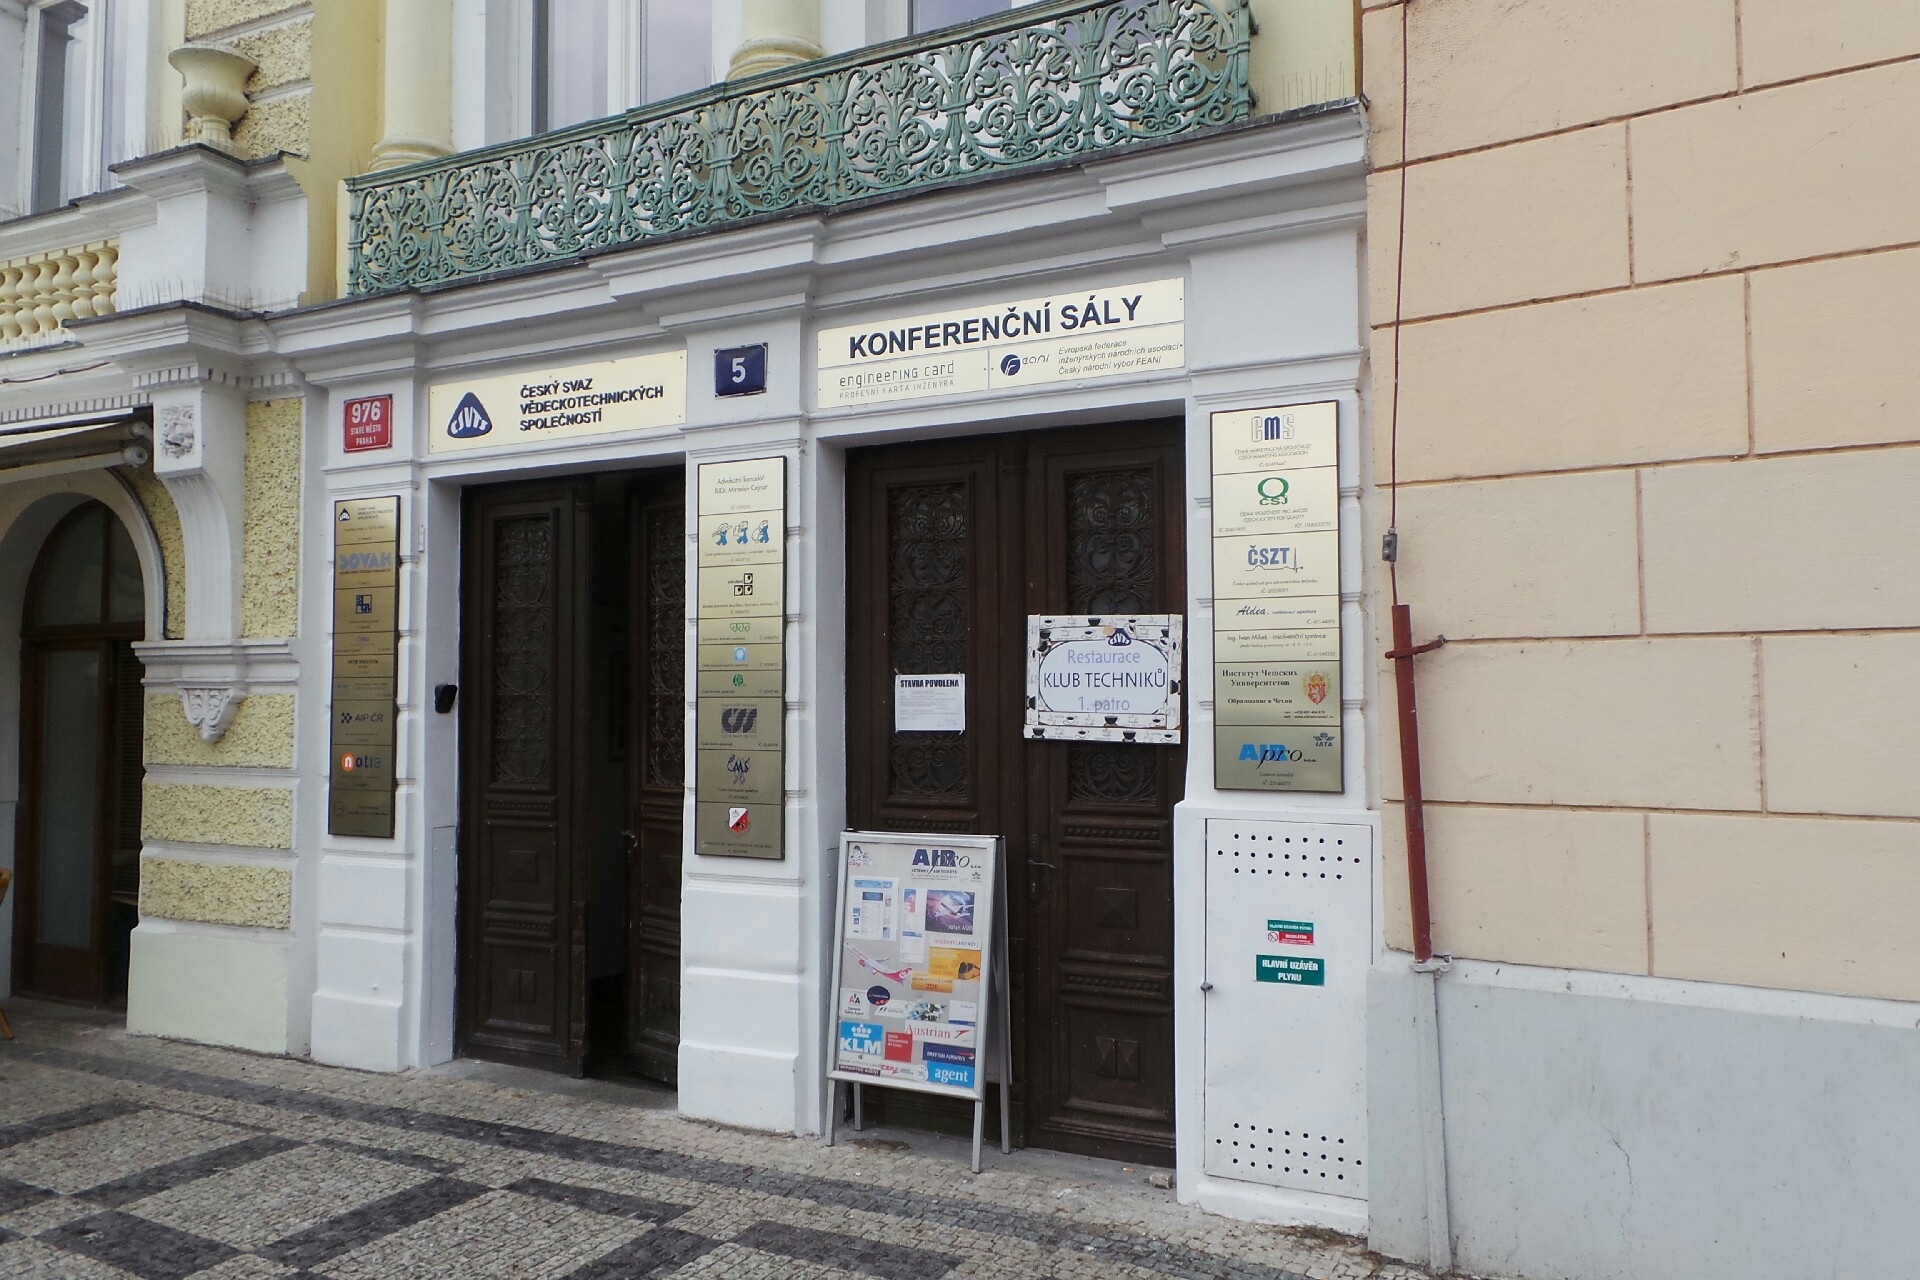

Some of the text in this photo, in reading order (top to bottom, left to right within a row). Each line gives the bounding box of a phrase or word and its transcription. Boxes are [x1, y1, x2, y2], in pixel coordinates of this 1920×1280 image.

[850, 295, 1142, 358] KONFERENČNÍ SÁLY
[1058, 342, 1179, 364] inženýrských národních asociací
[1059, 340, 1127, 355] Evropská federace
[731, 357, 746, 384] 5
[924, 360, 955, 376] card
[1058, 356, 1161, 376] Český národní výbor FEANI
[520, 378, 593, 399] ČESKÝ SVAZ
[839, 378, 955, 399] PROFESNÍ KARTA INŽENÝRA
[520, 384, 664, 416] VĚDECKOTECHNICKÝCH
[351, 401, 381, 424] 976
[520, 408, 602, 432] SPOLEČNOSTÍ
[350, 423, 382, 436] STARÉ MĚSTO
[355, 437, 373, 446] PRAHA
[1247, 545, 1290, 566] ČSZT
[1068, 650, 1141, 664] Restaurace
[1044, 668, 1166, 688] KLUB TECHNIKŮ
[1222, 669, 1260, 679] Институт
[900, 678, 960, 688] STAVBA POVOLENA
[1230, 679, 1290, 688] Университетов
[1078, 696, 1130, 713] 1. patro
[1262, 959, 1319, 971] HLAVNÍ UZÁVĚR
[1277, 972, 1302, 982] PLYNU
[906, 1024, 951, 1039] Austrian
[840, 1037, 881, 1055] KLM
[934, 1068, 969, 1083] agent
